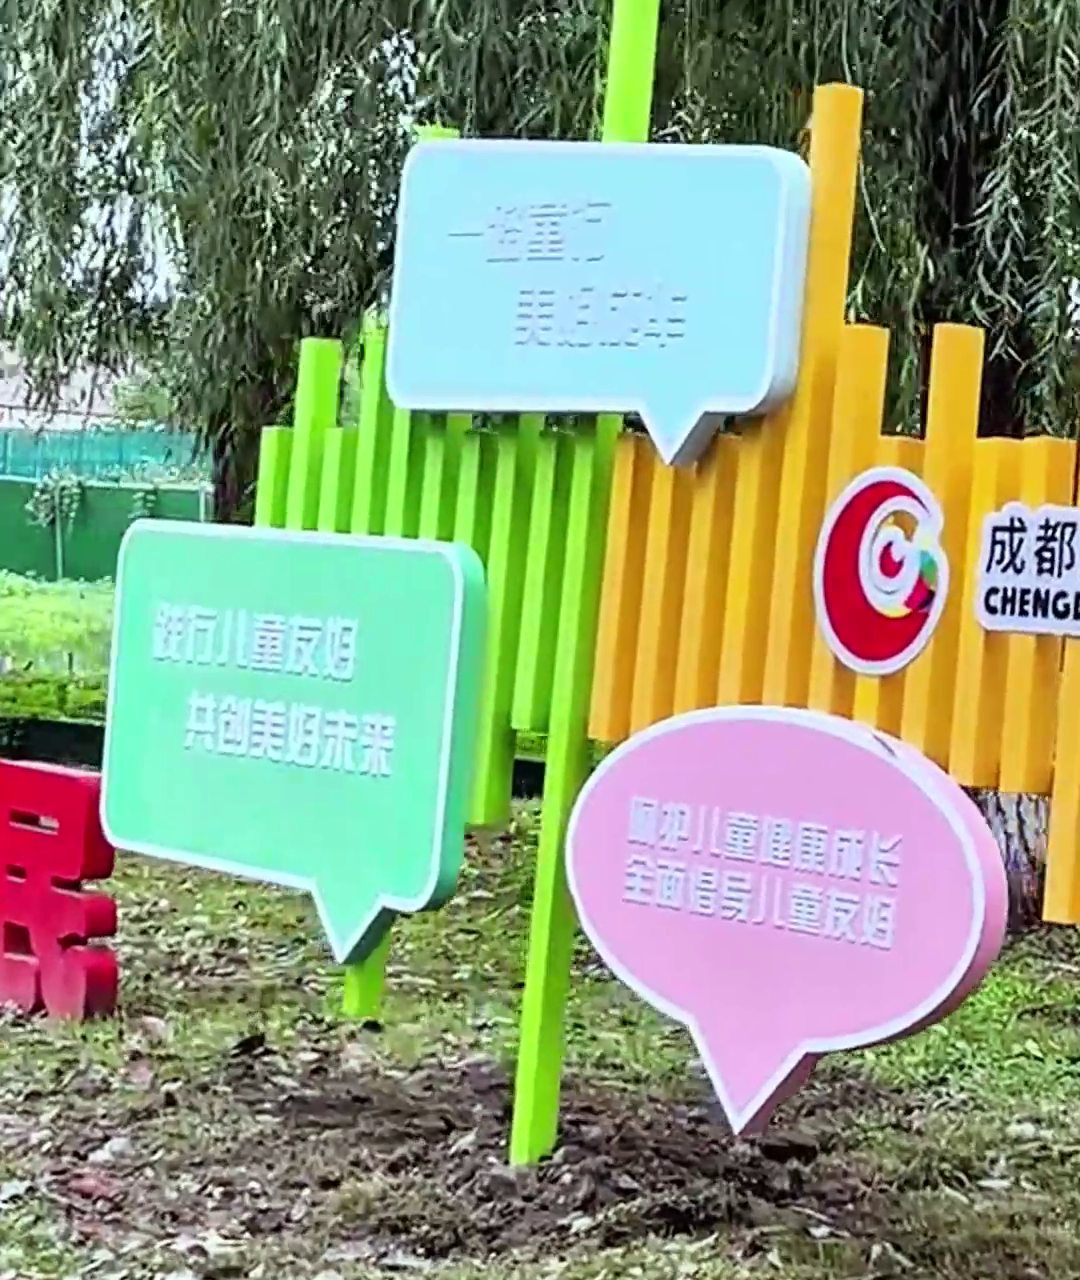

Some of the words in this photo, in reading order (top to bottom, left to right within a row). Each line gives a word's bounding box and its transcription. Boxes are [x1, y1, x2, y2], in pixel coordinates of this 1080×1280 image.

[151, 600, 359, 682] 践行儿童友好
[183, 689, 397, 778] 共创美好未来
[626, 794, 904, 888] 呵护儿童健康成长
[621, 854, 897, 952] 全面倡导儿童友好
